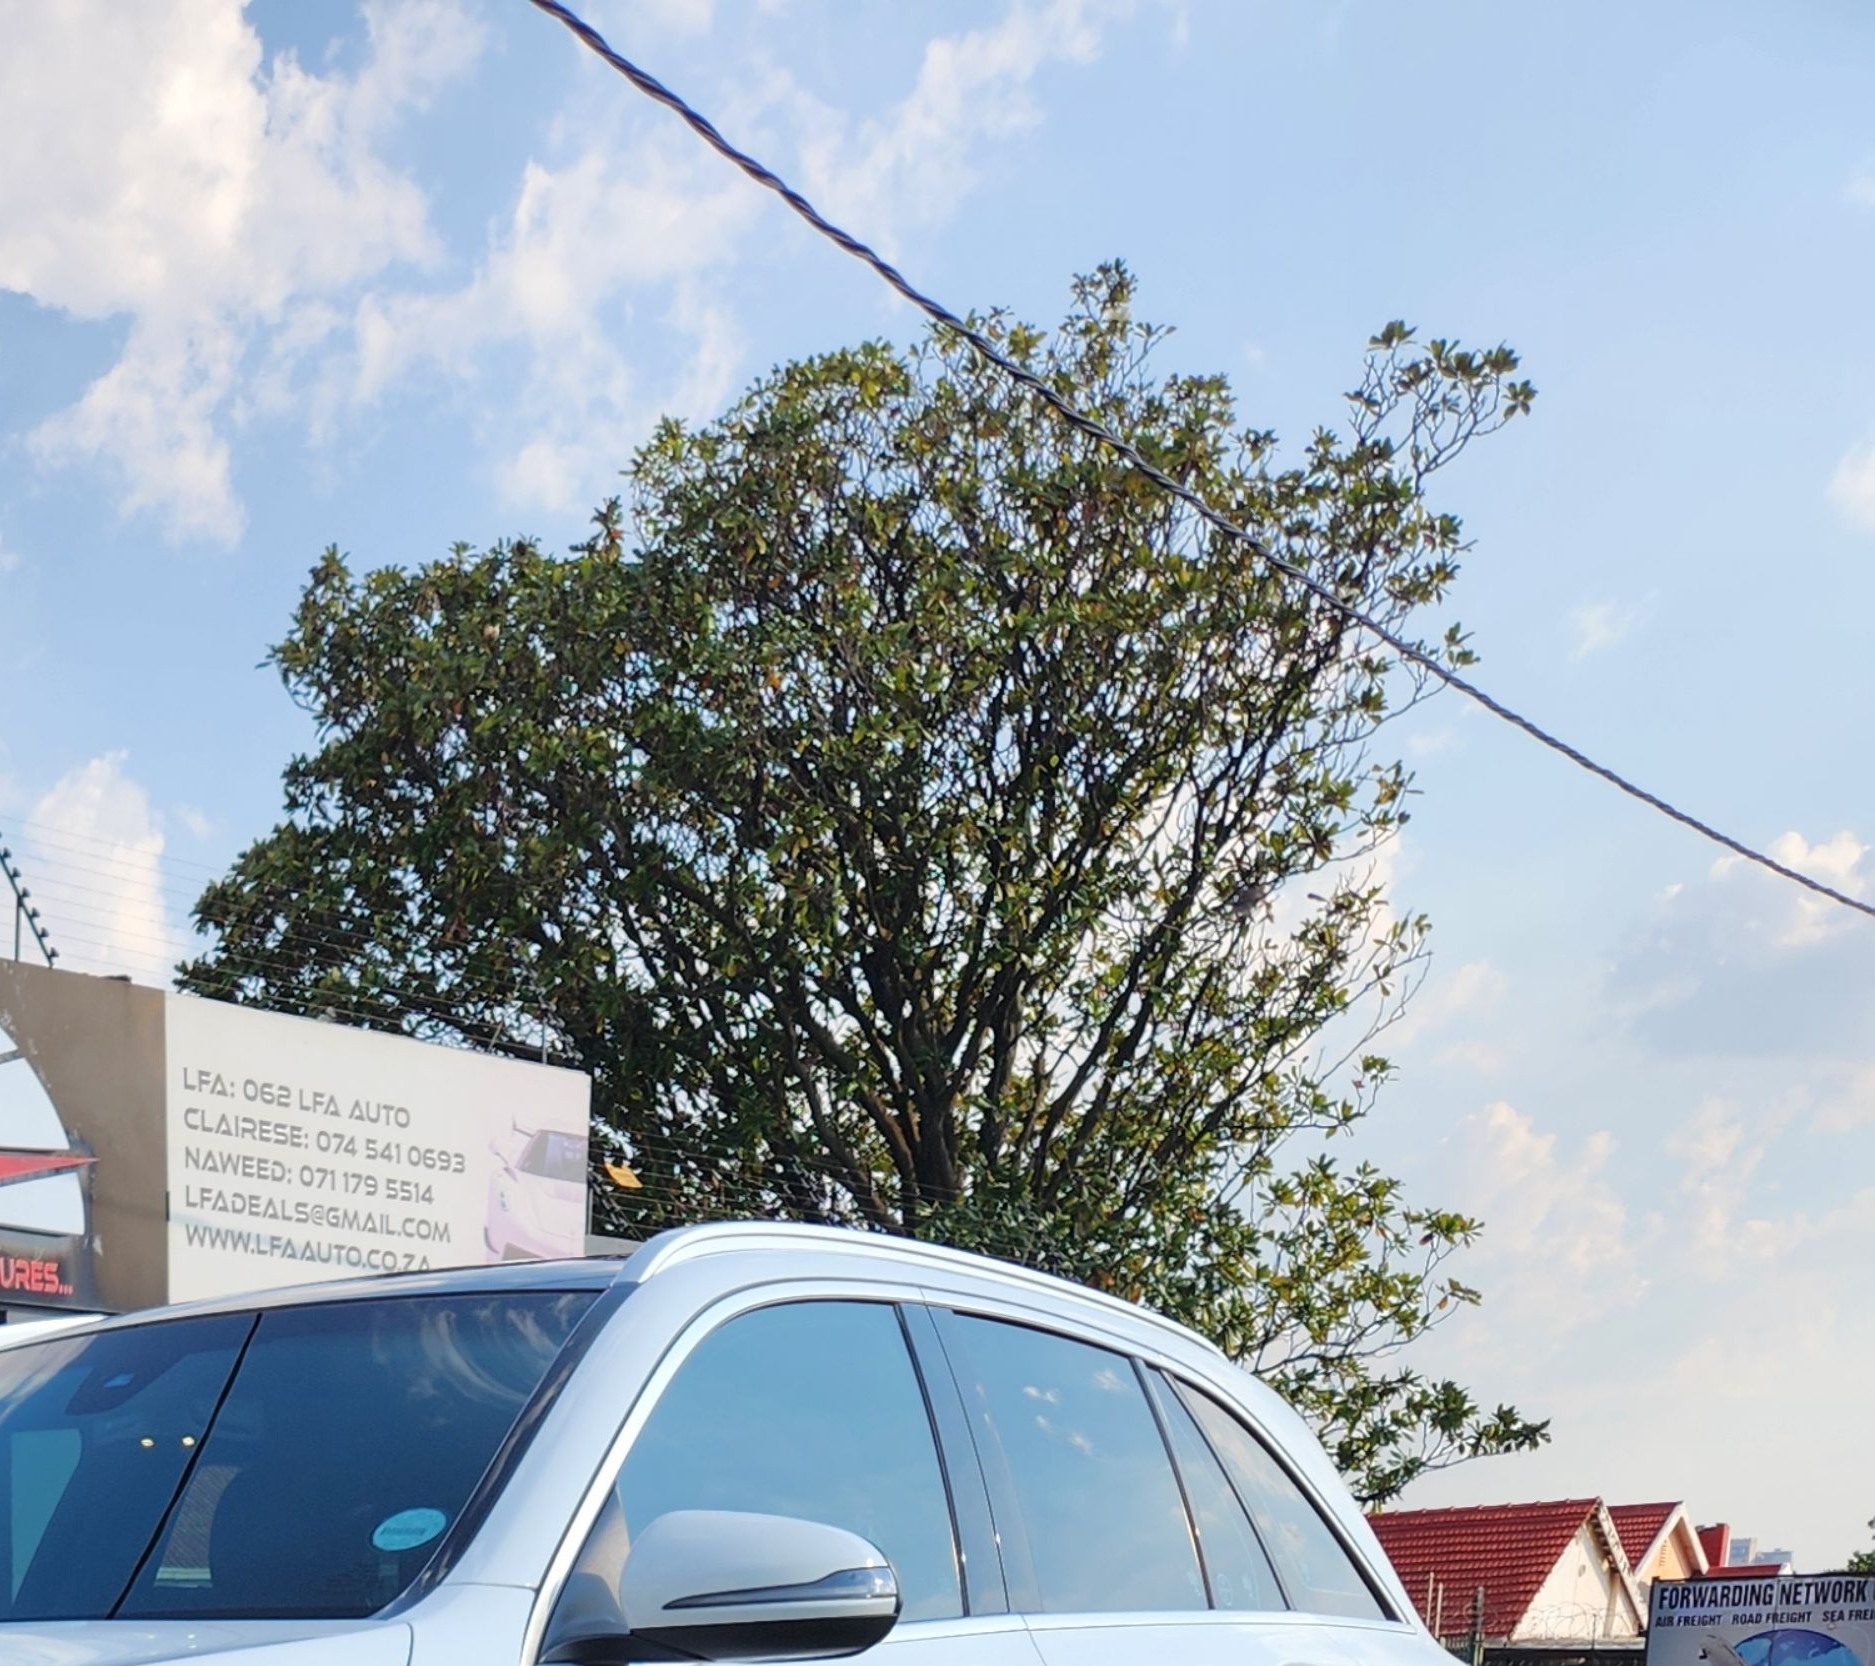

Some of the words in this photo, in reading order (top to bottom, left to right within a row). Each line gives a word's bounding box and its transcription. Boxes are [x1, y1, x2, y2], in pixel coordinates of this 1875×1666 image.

[182, 1066, 236, 1099] LFA:
[242, 1078, 292, 1108] 062
[298, 1087, 342, 1117] LFA
[348, 1098, 411, 1129] AUTO
[183, 1106, 309, 1151] CLAIRESE:
[315, 1129, 359, 1156] 074
[364, 1138, 401, 1165] 541
[407, 1145, 467, 1173] 0693
[184, 1145, 293, 1185] NAWEED:
[298, 1163, 338, 1192] 071
[342, 1170, 378, 1197] 179
[385, 1177, 434, 1205] 5514
[184, 1184, 451, 1244] LFADEALS@GMAIL.COM
[184, 1222, 432, 1274] WWW.LFAAUTO.CO.ZA
[1655, 1615, 1674, 1627] AIR
[1676, 1614, 1722, 1627] FREIGHT
[1732, 1612, 1762, 1625] ROAD
[1766, 1611, 1813, 1624] FREIGHT
[1823, 1610, 1845, 1622] SEA
[1658, 1583, 1774, 1610] FORWARDING
[1779, 1580, 1868, 1605] NETWORK
